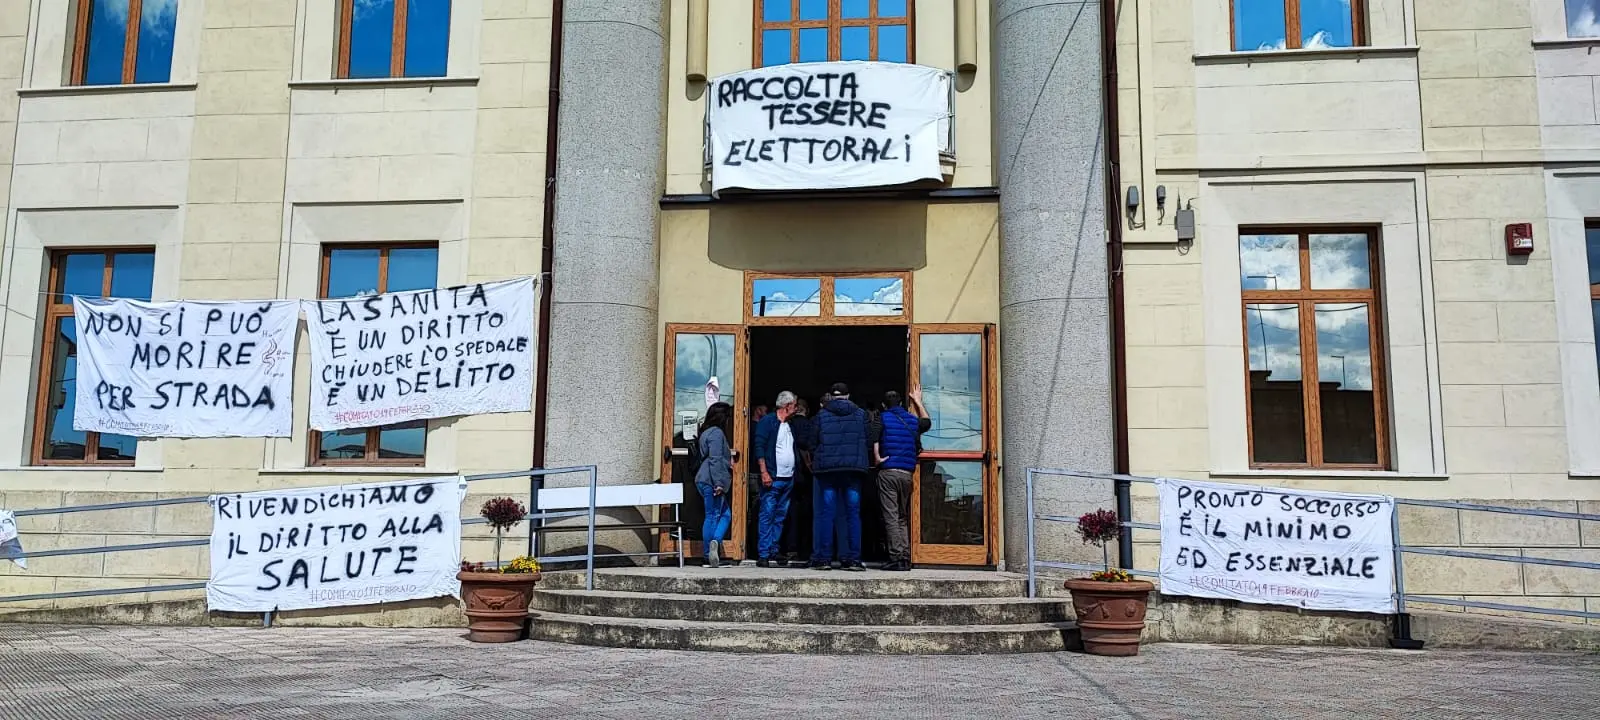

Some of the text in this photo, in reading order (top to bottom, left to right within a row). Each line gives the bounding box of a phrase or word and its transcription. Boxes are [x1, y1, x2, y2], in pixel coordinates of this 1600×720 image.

[718, 72, 859, 107] RACCOLTA
[761, 100, 892, 130] TESSERE
[85, 312, 142, 337] NON
[358, 330, 387, 350] UN
[96, 380, 276, 411] PER STRADA
[1178, 486, 1380, 517] PRONTO SOCCORSO
[378, 514, 443, 538] ALLA
[256, 546, 419, 591] SALUTE
[1177, 547, 1207, 568] ED
